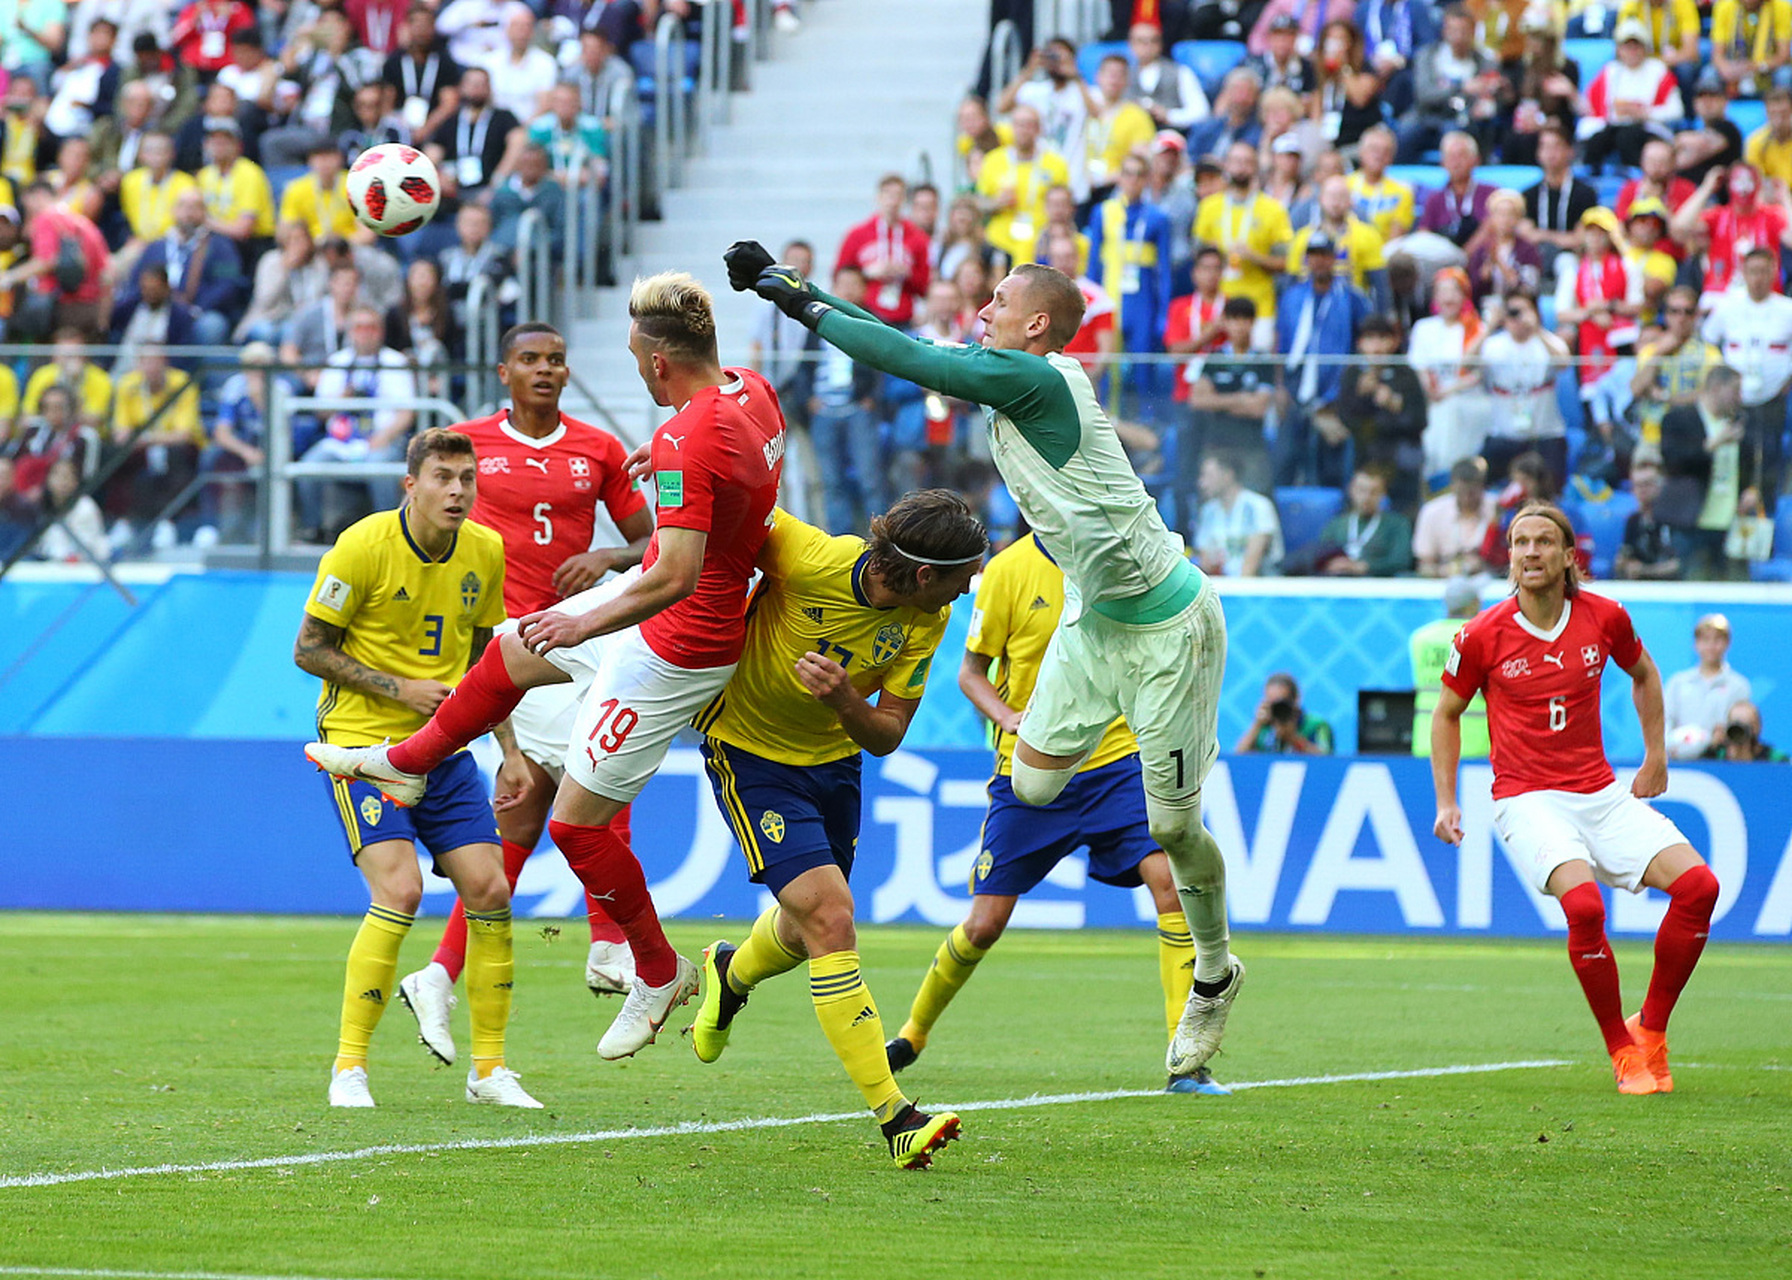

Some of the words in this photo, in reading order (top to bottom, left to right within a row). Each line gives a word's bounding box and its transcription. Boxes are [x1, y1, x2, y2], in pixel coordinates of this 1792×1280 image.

[533, 502, 553, 545] 5
[419, 615, 443, 656] 3
[588, 698, 638, 753] 19
[1549, 695, 1566, 732] 6
[1169, 748, 1184, 789] 1
[1131, 760, 1792, 937] WAND
